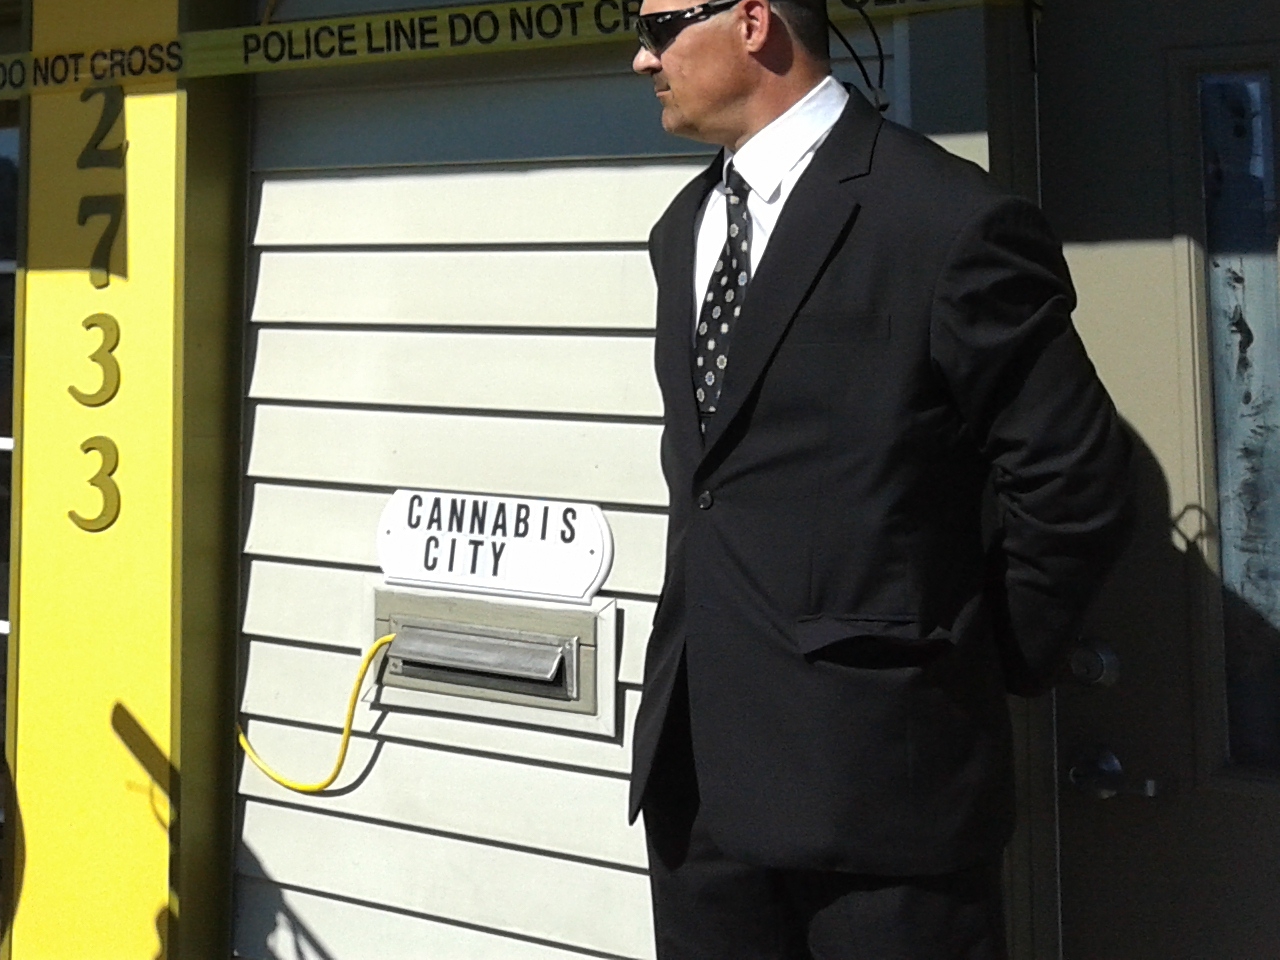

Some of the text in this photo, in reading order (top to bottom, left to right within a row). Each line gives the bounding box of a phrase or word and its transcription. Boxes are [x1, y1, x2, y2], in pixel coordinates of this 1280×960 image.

[243, 23, 357, 65] POLICE
[366, 15, 439, 53] LINE
[448, 10, 500, 48] DO
[509, 1, 585, 40] NOT
[33, 53, 84, 87] NOT
[90, 41, 183, 81] CROSS
[407, 494, 577, 544] CANNABIS
[423, 535, 506, 577] CITY
